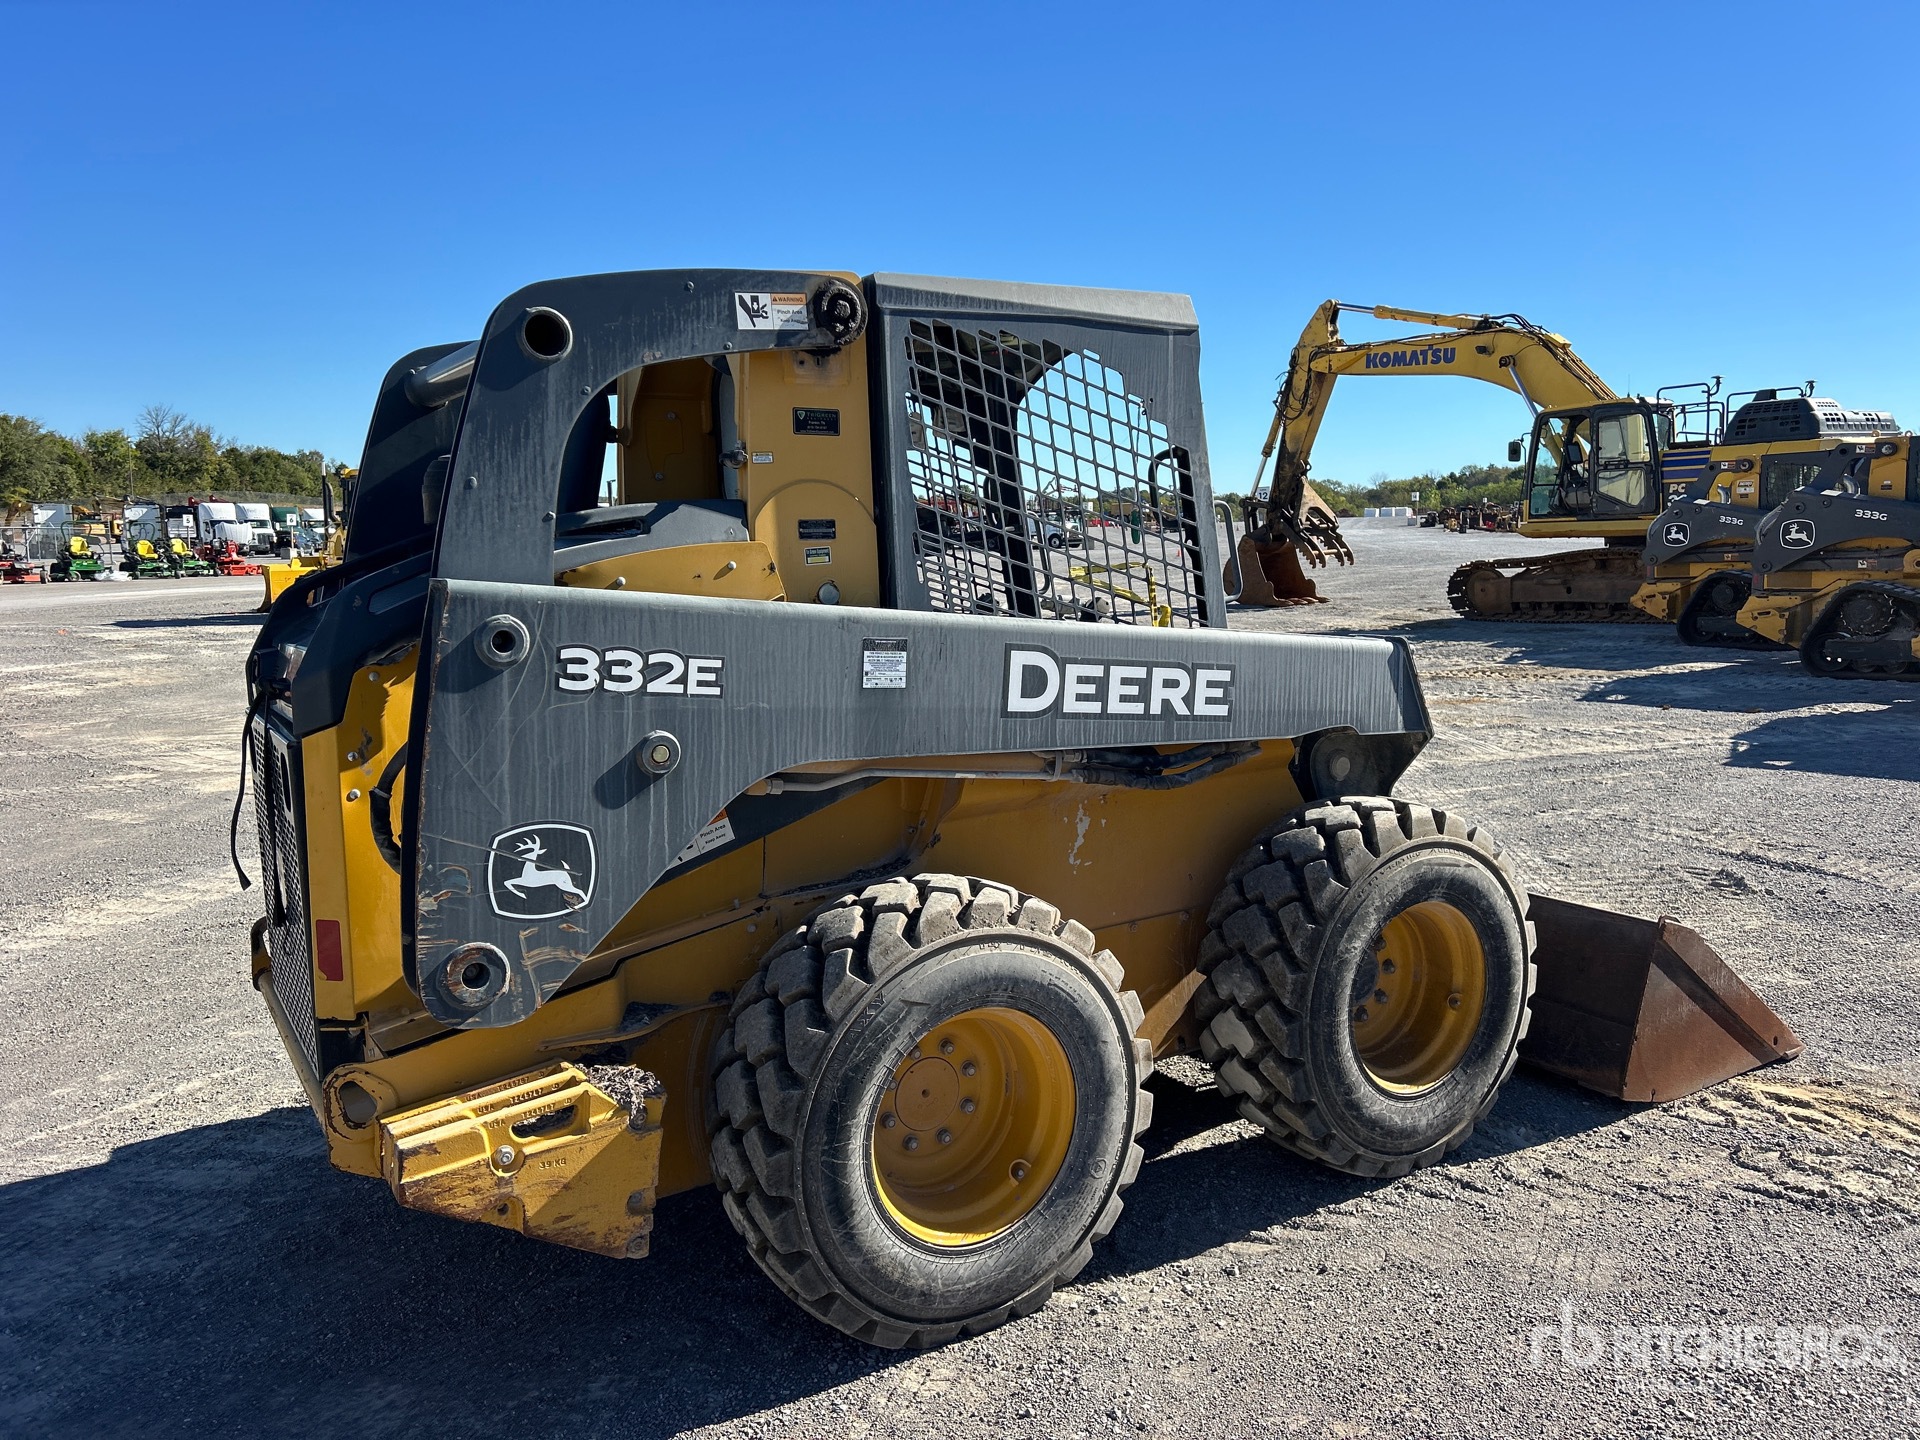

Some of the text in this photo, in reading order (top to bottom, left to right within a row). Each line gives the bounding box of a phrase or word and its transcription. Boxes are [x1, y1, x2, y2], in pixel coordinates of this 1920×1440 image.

[1365, 344, 1456, 369] KOMATSU
[1669, 483, 1686, 493] PC
[1258, 491, 1268, 500] 12
[1719, 515, 1743, 526] 333G
[1855, 509, 1888, 521] 333G
[558, 647, 722, 696] 332E
[1007, 650, 1231, 716] DEERE
[700, 824, 726, 839] Pinch Area
[478, 1104, 494, 1114] USA
[489, 1119, 505, 1129] USA
[539, 1158, 566, 1169] 39 KG
